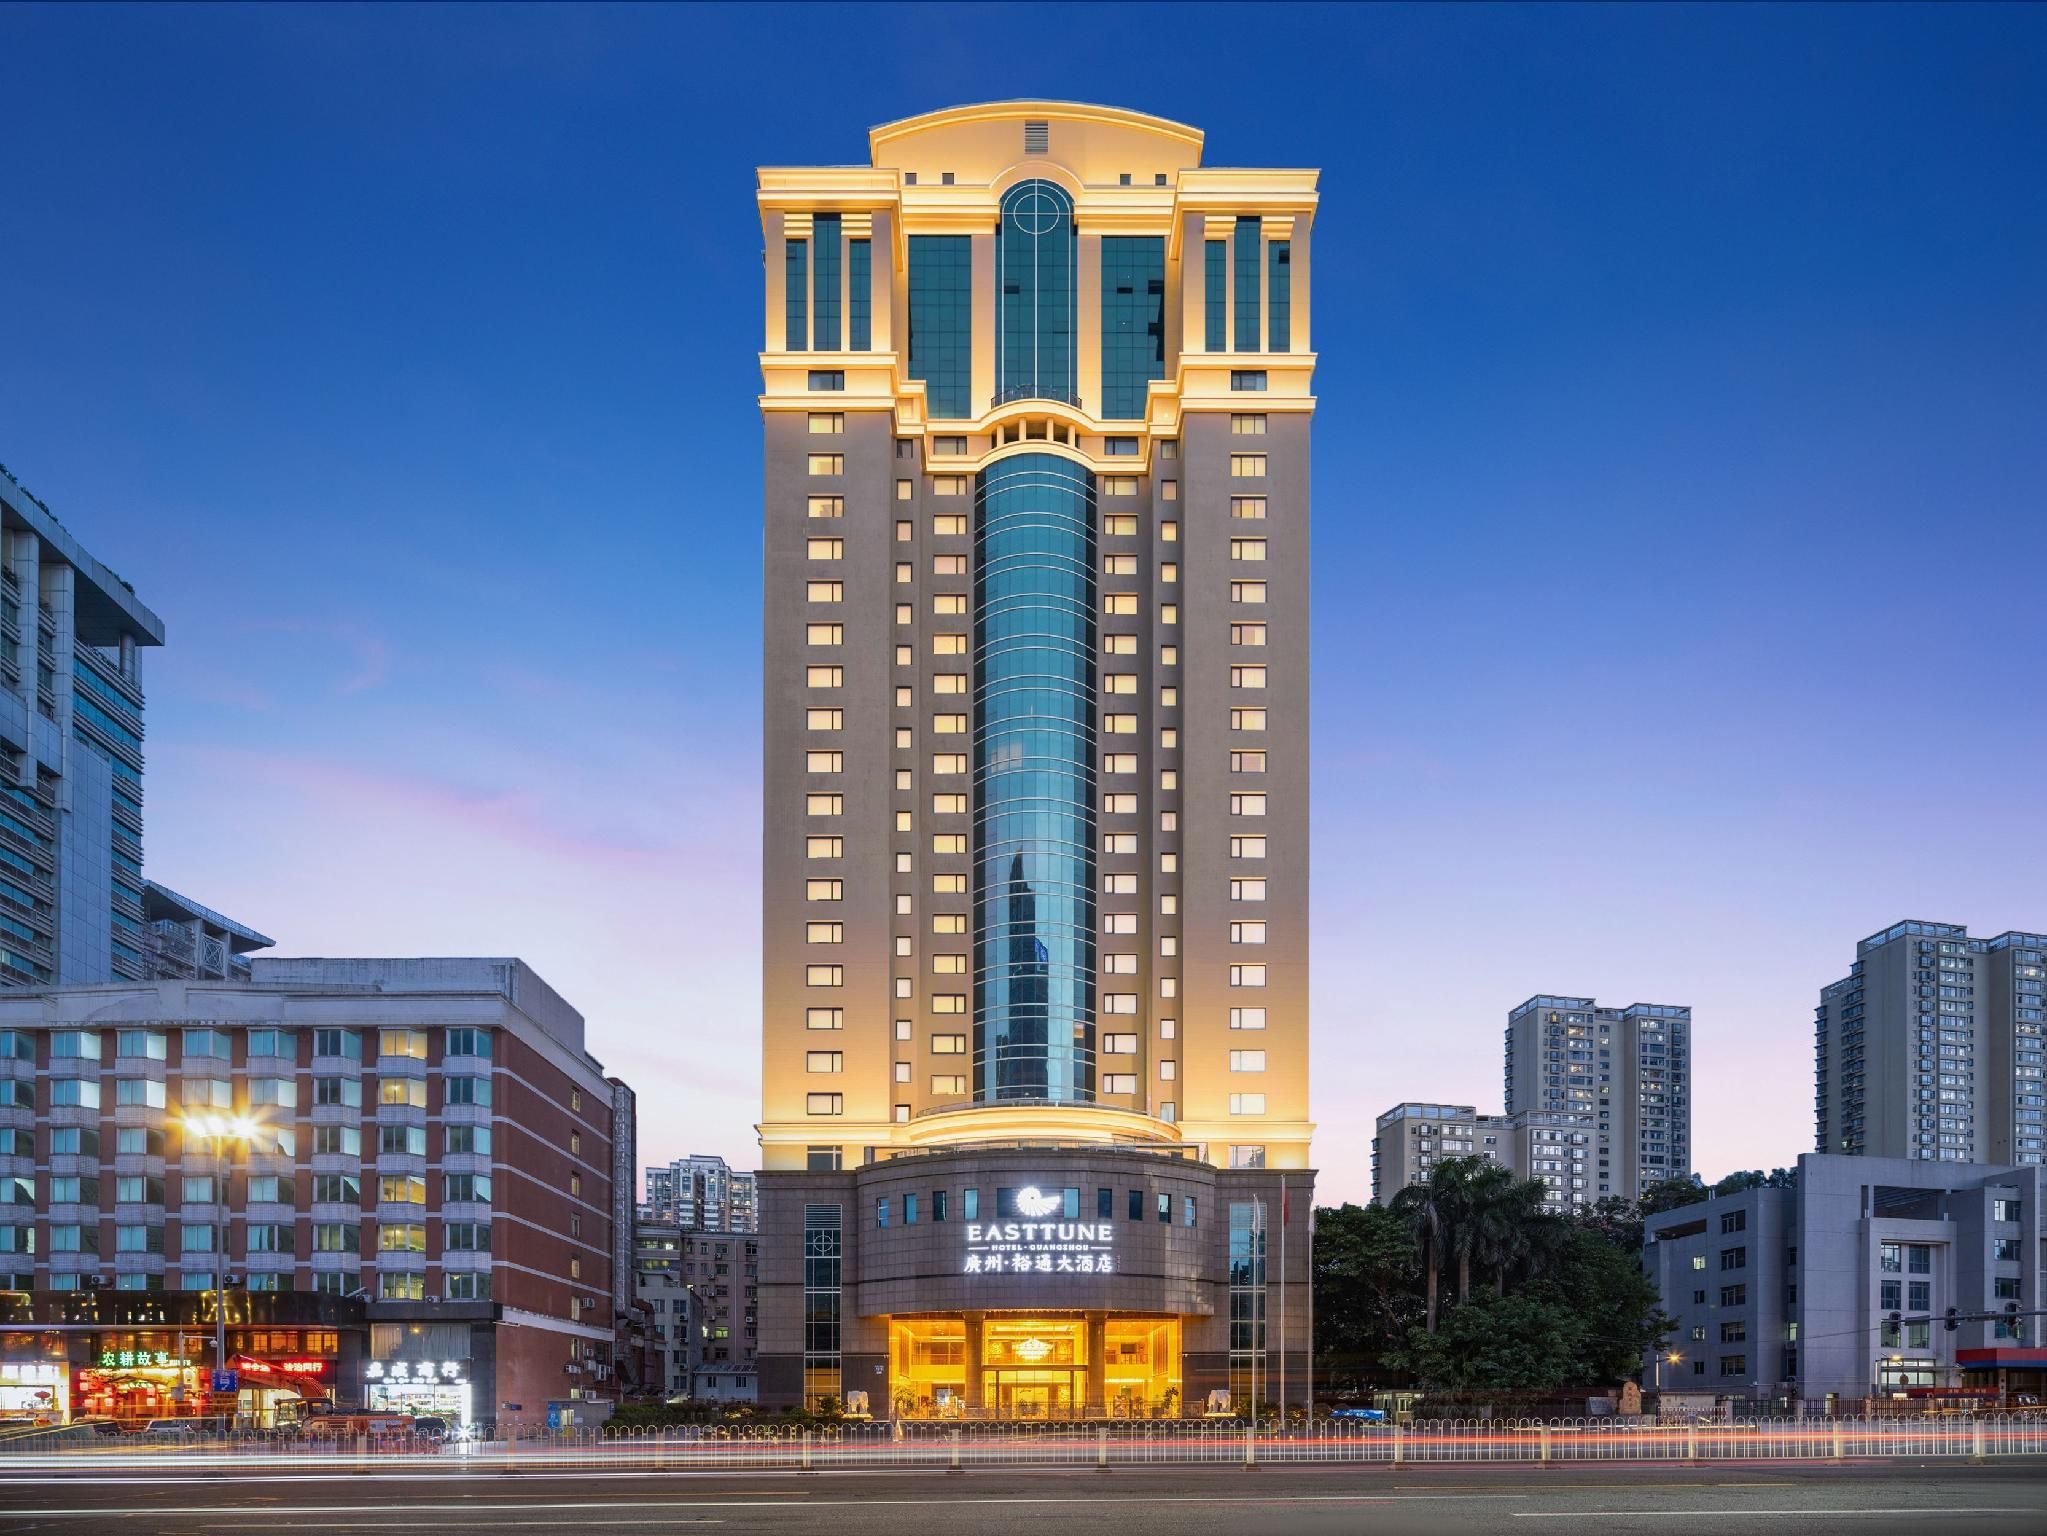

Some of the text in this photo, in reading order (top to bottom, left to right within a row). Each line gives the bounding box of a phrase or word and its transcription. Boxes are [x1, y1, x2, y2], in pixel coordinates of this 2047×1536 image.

[967, 1223, 1113, 1241] EASTTUNE
[102, 1351, 169, 1366] 农耕故事
